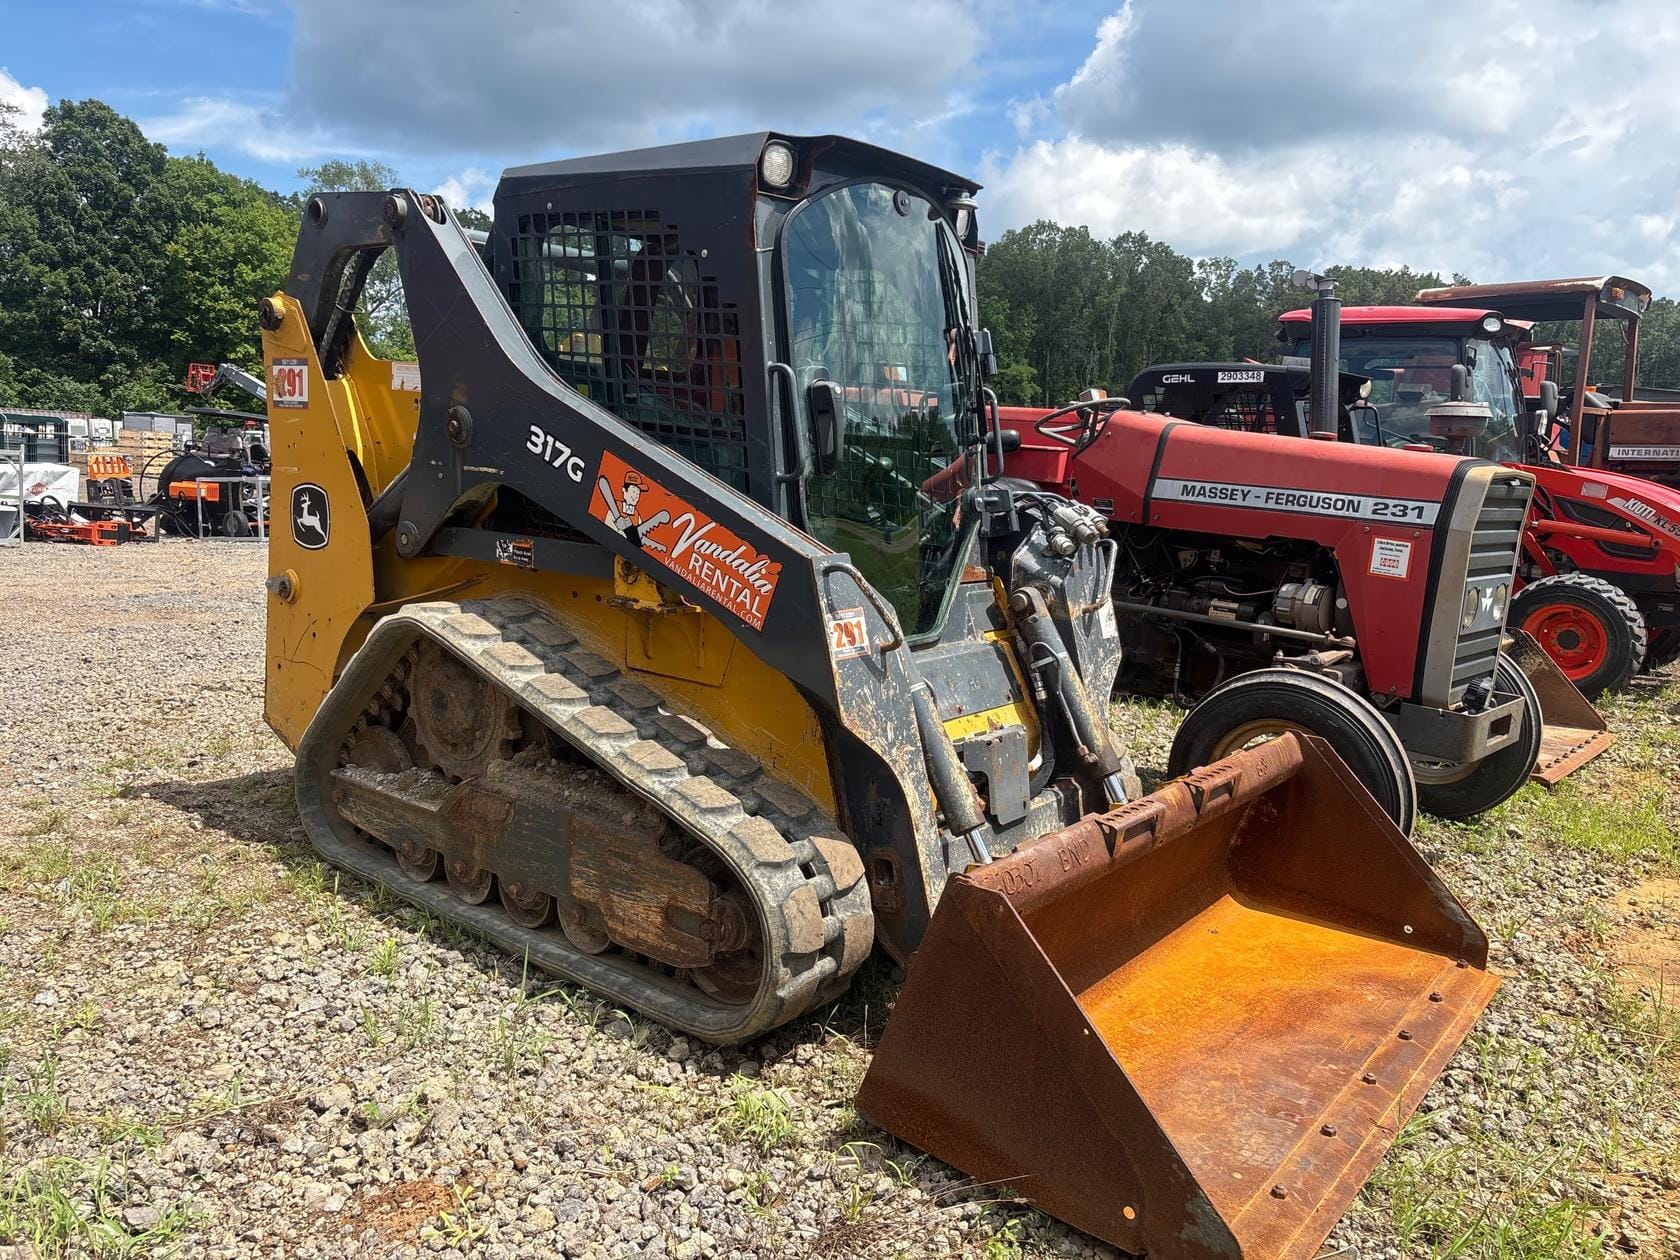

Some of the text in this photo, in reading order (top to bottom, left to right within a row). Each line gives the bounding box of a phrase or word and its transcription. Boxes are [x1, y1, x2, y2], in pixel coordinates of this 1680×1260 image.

[1162, 374, 1195, 384] GEHL
[1220, 370, 1262, 381] 2903348
[525, 424, 586, 483] 317G
[1617, 448, 1680, 457] INTERNATI
[1371, 502, 1426, 520] 231
[1624, 498, 1657, 520] KIOTI
[672, 512, 773, 595] Vandalia
[664, 557, 761, 628] VANDALIARENTAL.COM
[688, 552, 762, 618] RENTAL
[832, 620, 865, 648] 291
